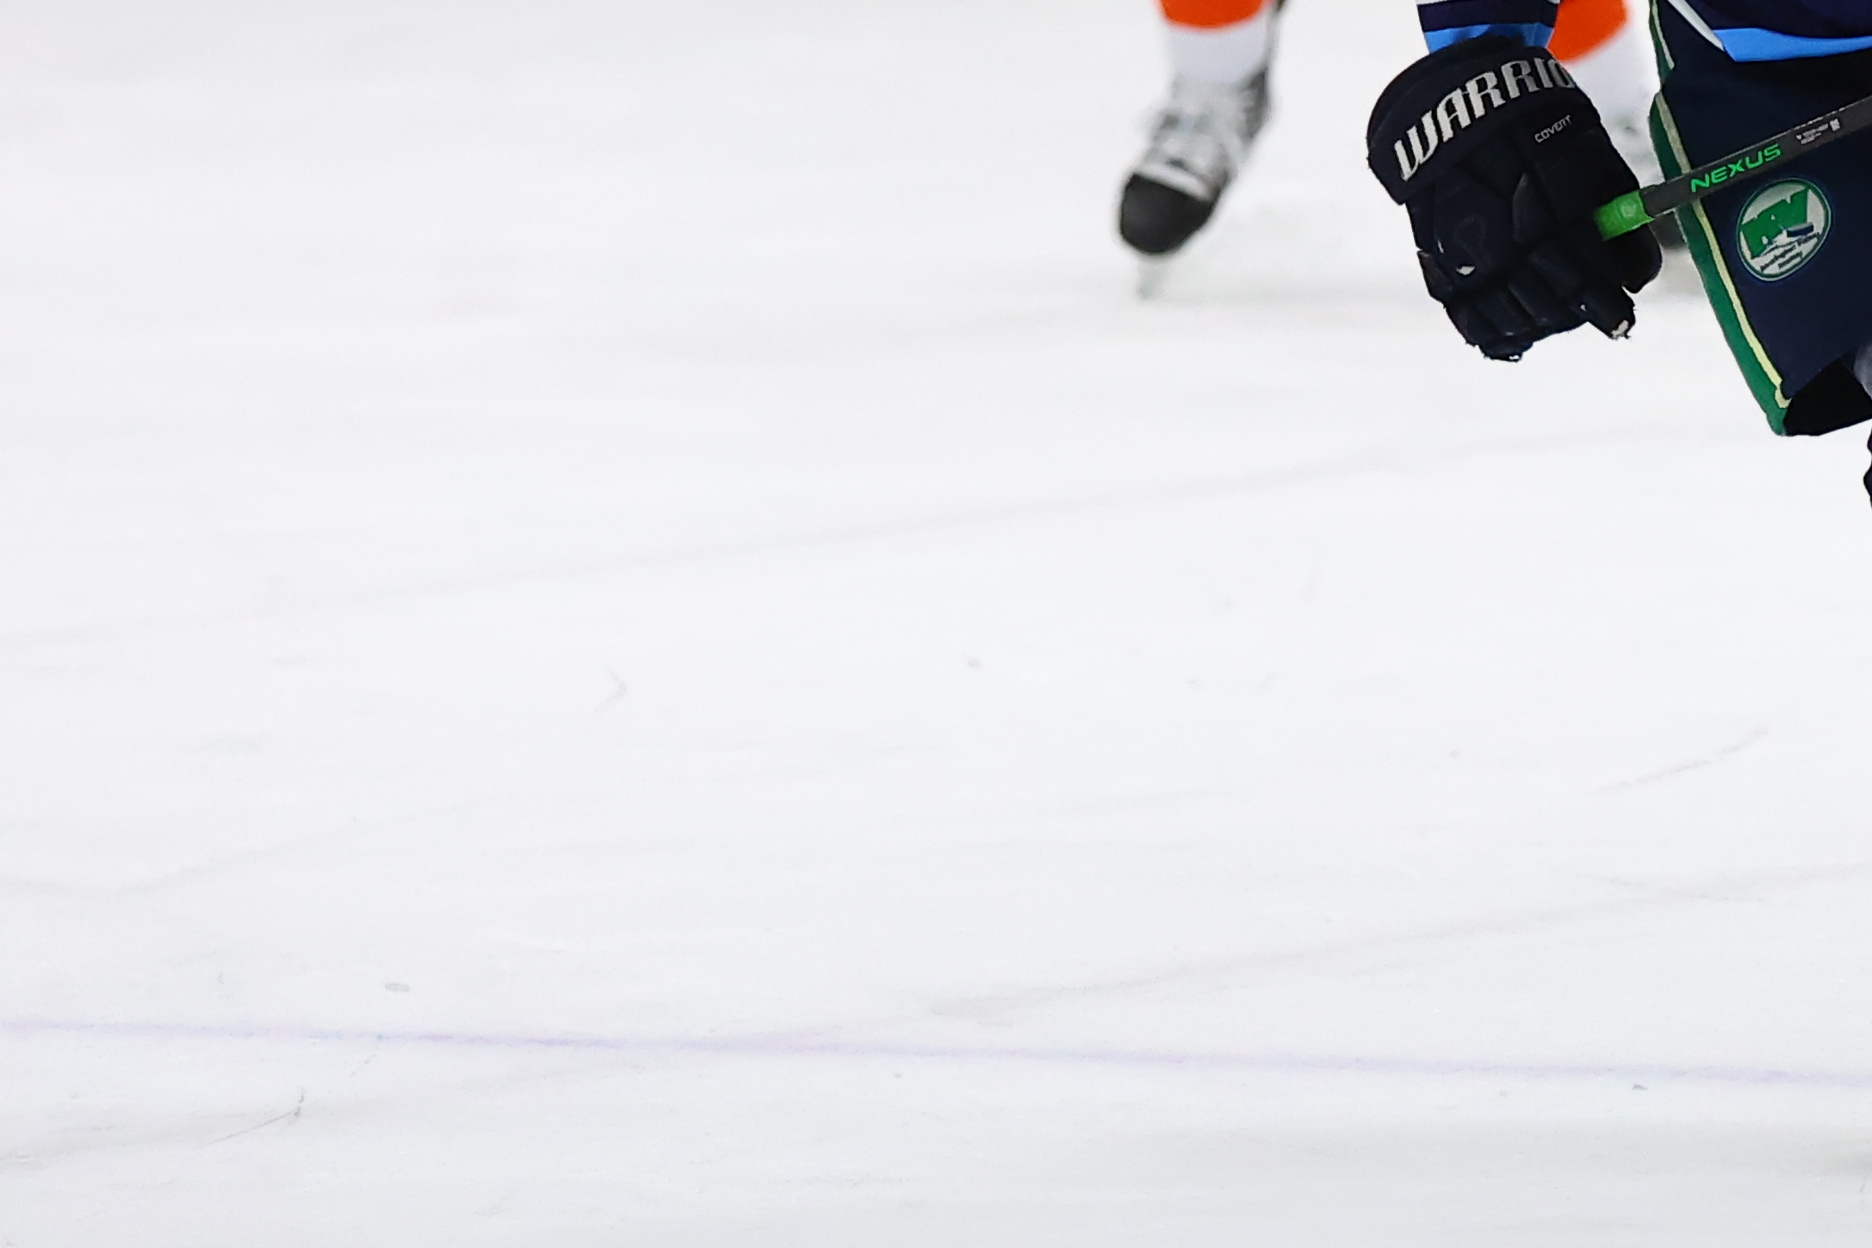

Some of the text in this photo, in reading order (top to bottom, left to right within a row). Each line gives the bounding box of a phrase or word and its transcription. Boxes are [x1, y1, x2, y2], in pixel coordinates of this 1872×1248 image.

[1393, 56, 1577, 182] WARRIO
[1534, 114, 1572, 143] COVERT
[1690, 143, 1783, 193] NEXUS
